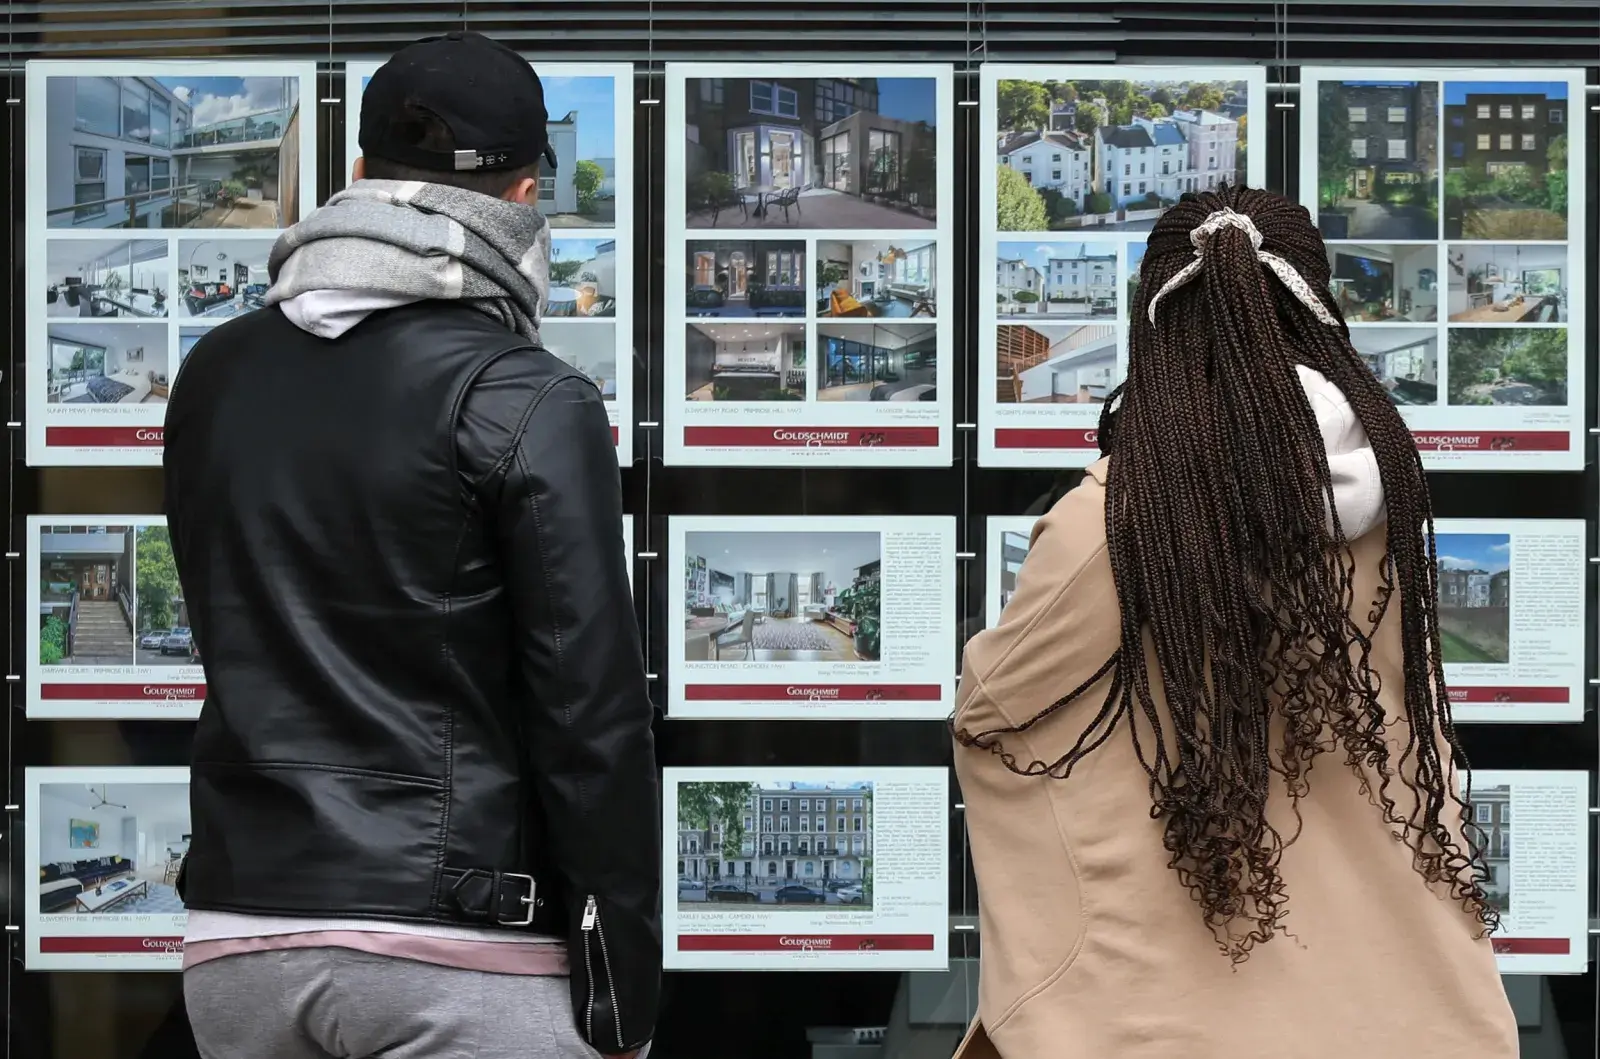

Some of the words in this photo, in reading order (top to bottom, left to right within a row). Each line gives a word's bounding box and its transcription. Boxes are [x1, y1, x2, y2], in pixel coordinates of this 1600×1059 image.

[773, 429, 850, 441] GOLDSCHMIDT
[143, 686, 196, 696] GOLDSCHMIDT
[786, 686, 839, 696] GOLDSCHMIDT
[779, 936, 832, 946] GOLDSCHMIDT
